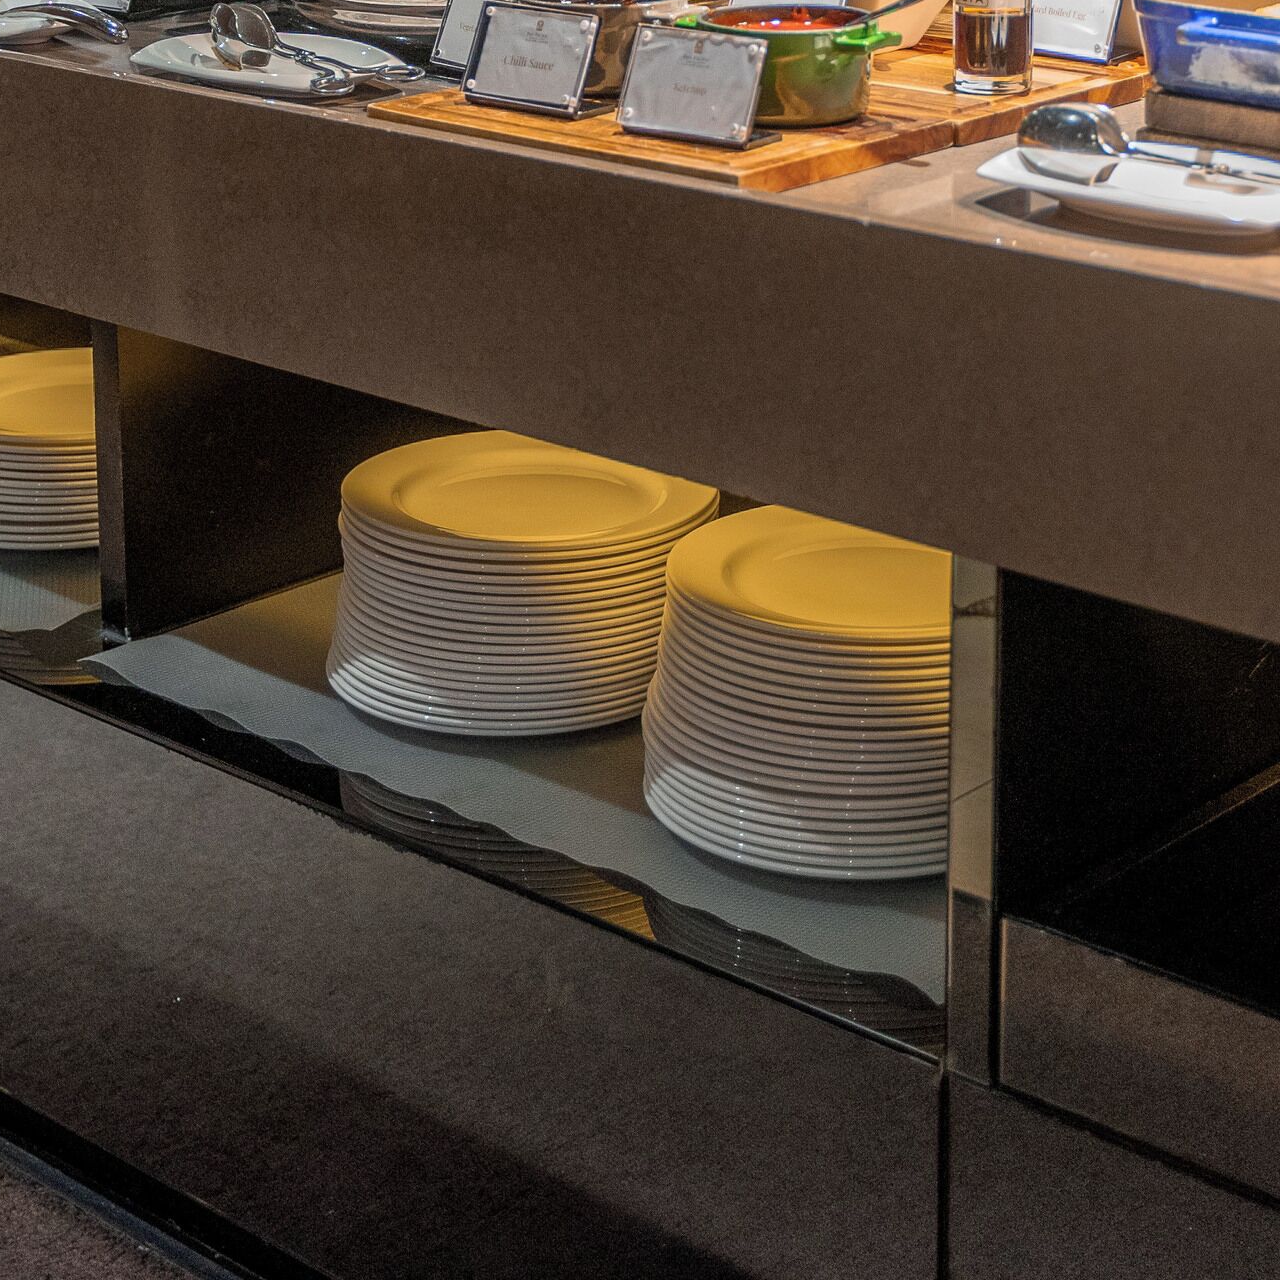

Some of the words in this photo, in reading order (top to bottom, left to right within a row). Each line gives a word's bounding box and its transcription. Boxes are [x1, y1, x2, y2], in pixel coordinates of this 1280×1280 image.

[1033, 4, 1047, 14] ard
[1048, 7, 1072, 18] Boiled
[503, 55, 527, 67] Chilli
[529, 59, 555, 71] Sauce
